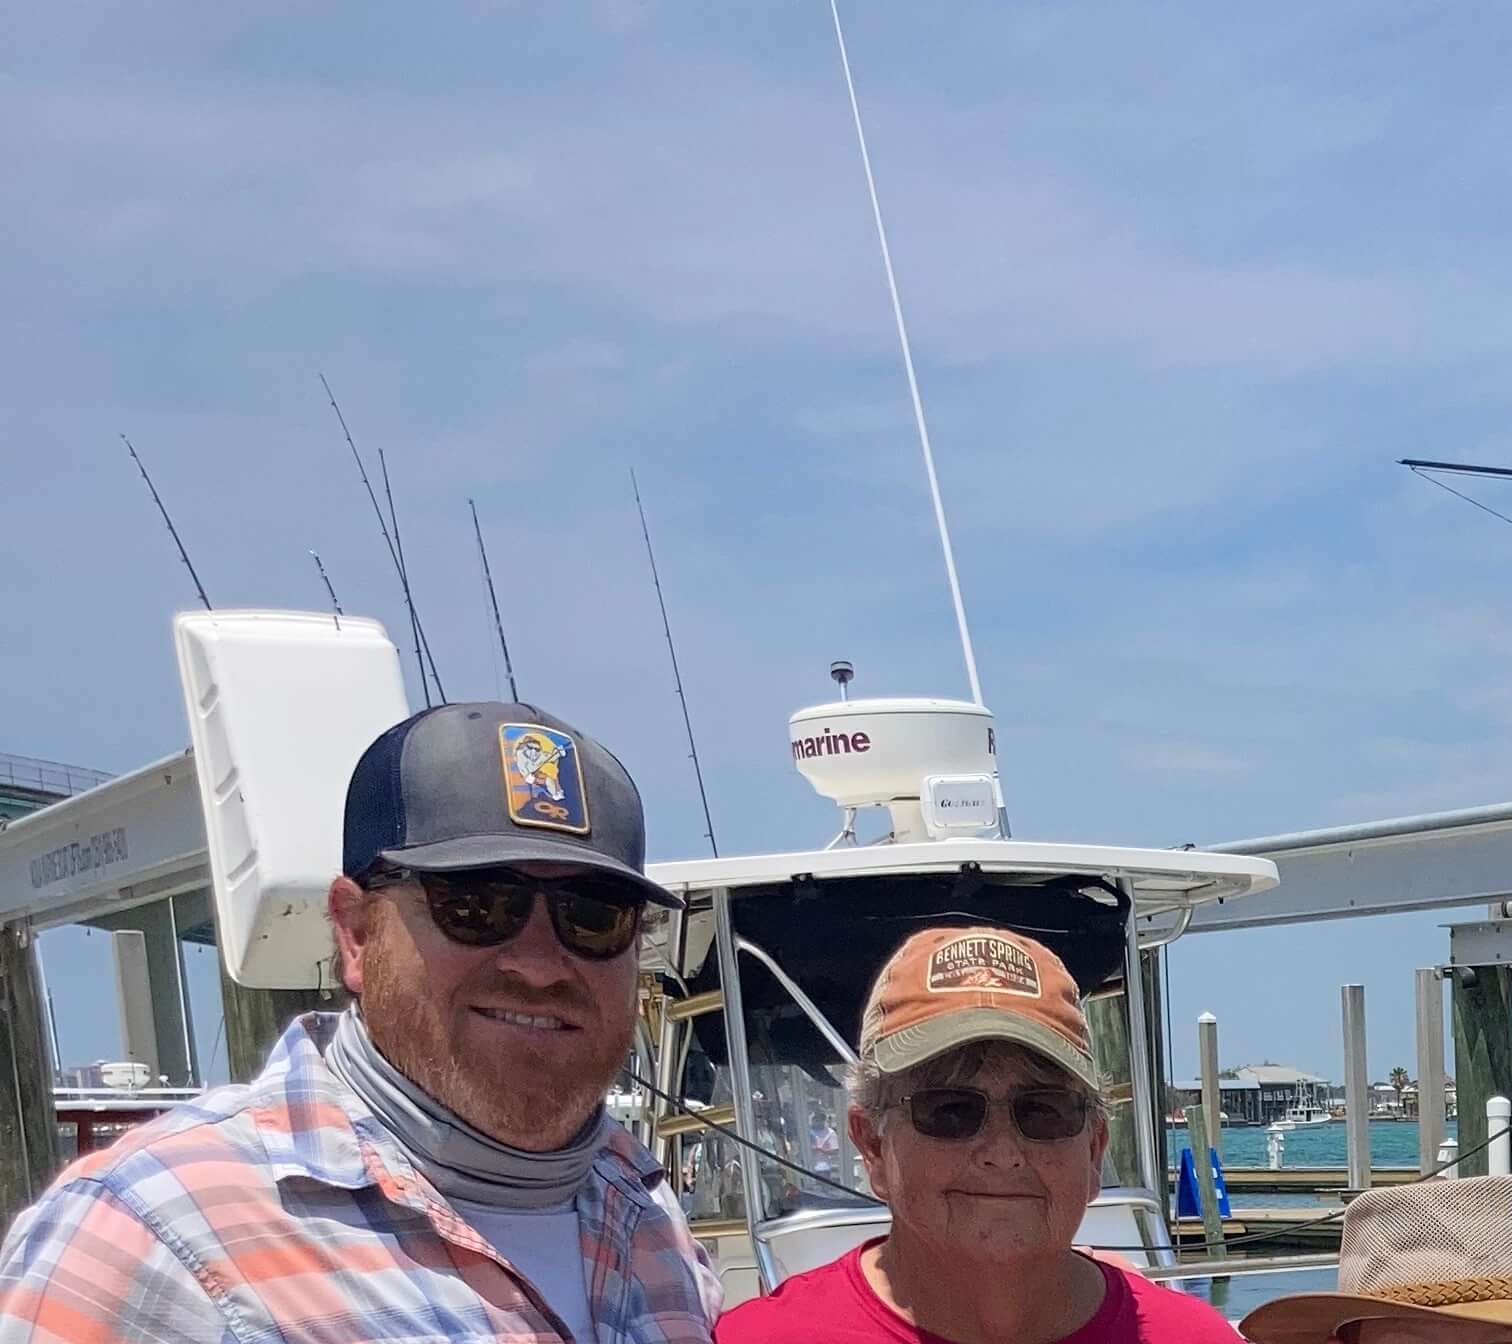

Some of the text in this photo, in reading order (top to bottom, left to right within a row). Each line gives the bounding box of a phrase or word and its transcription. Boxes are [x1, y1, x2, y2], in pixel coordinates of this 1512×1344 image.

[534, 801, 569, 820] OR
[936, 940, 1033, 971] BENNETT SPRING
[946, 957, 1025, 976] STATE PARK
